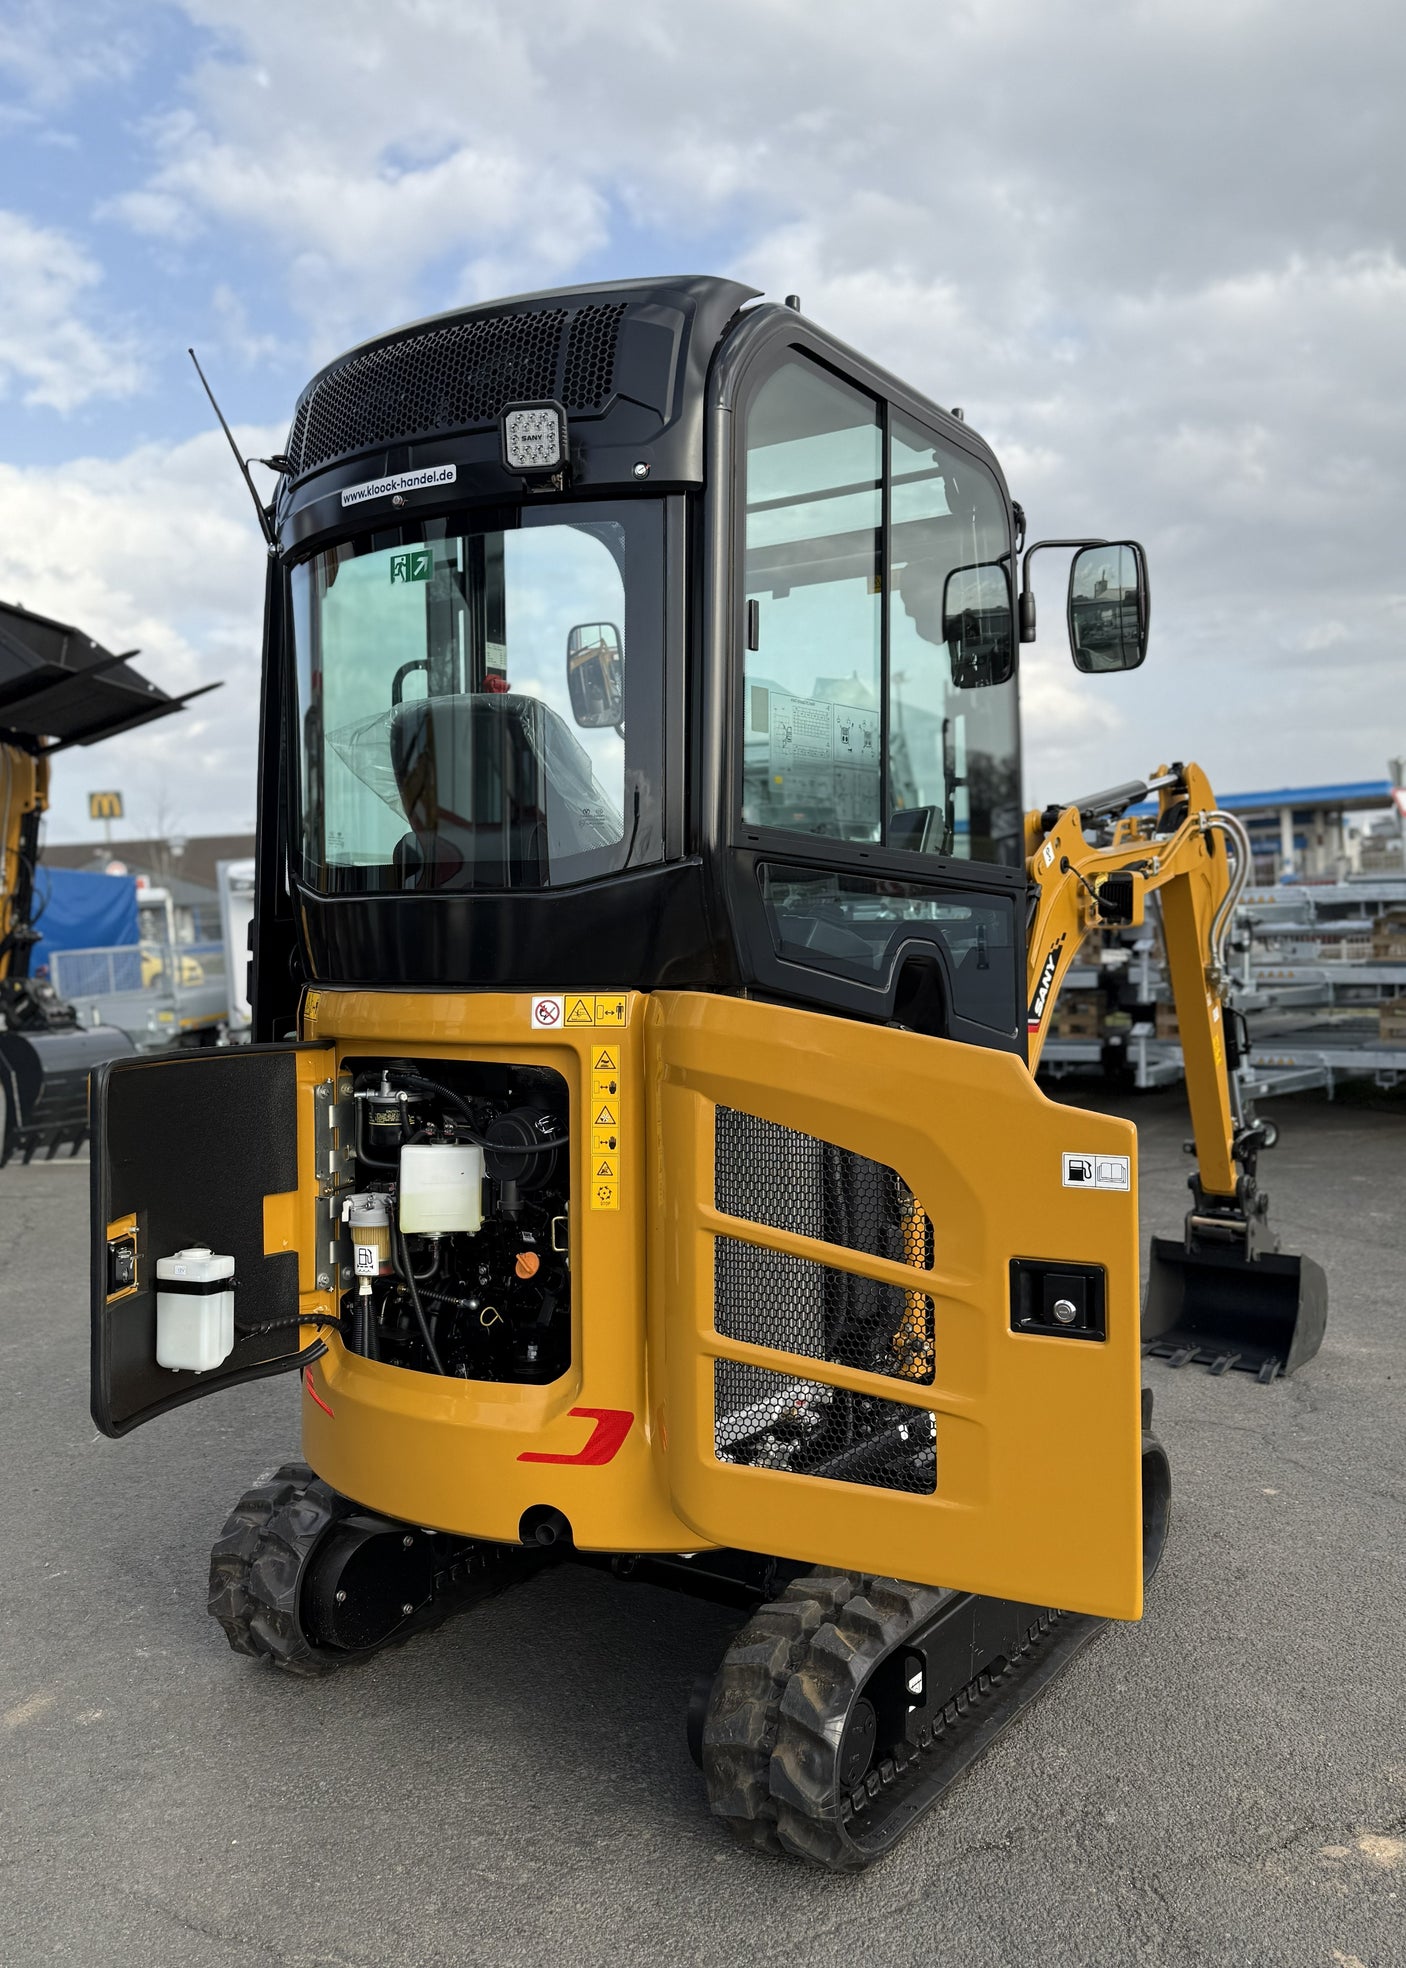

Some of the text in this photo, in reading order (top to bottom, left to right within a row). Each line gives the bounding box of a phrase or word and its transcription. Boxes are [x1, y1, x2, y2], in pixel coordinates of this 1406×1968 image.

[521, 434, 543, 442] SANY
[343, 469, 454, 504] www.kloock-handel.de
[1034, 954, 1055, 1018] SANY
